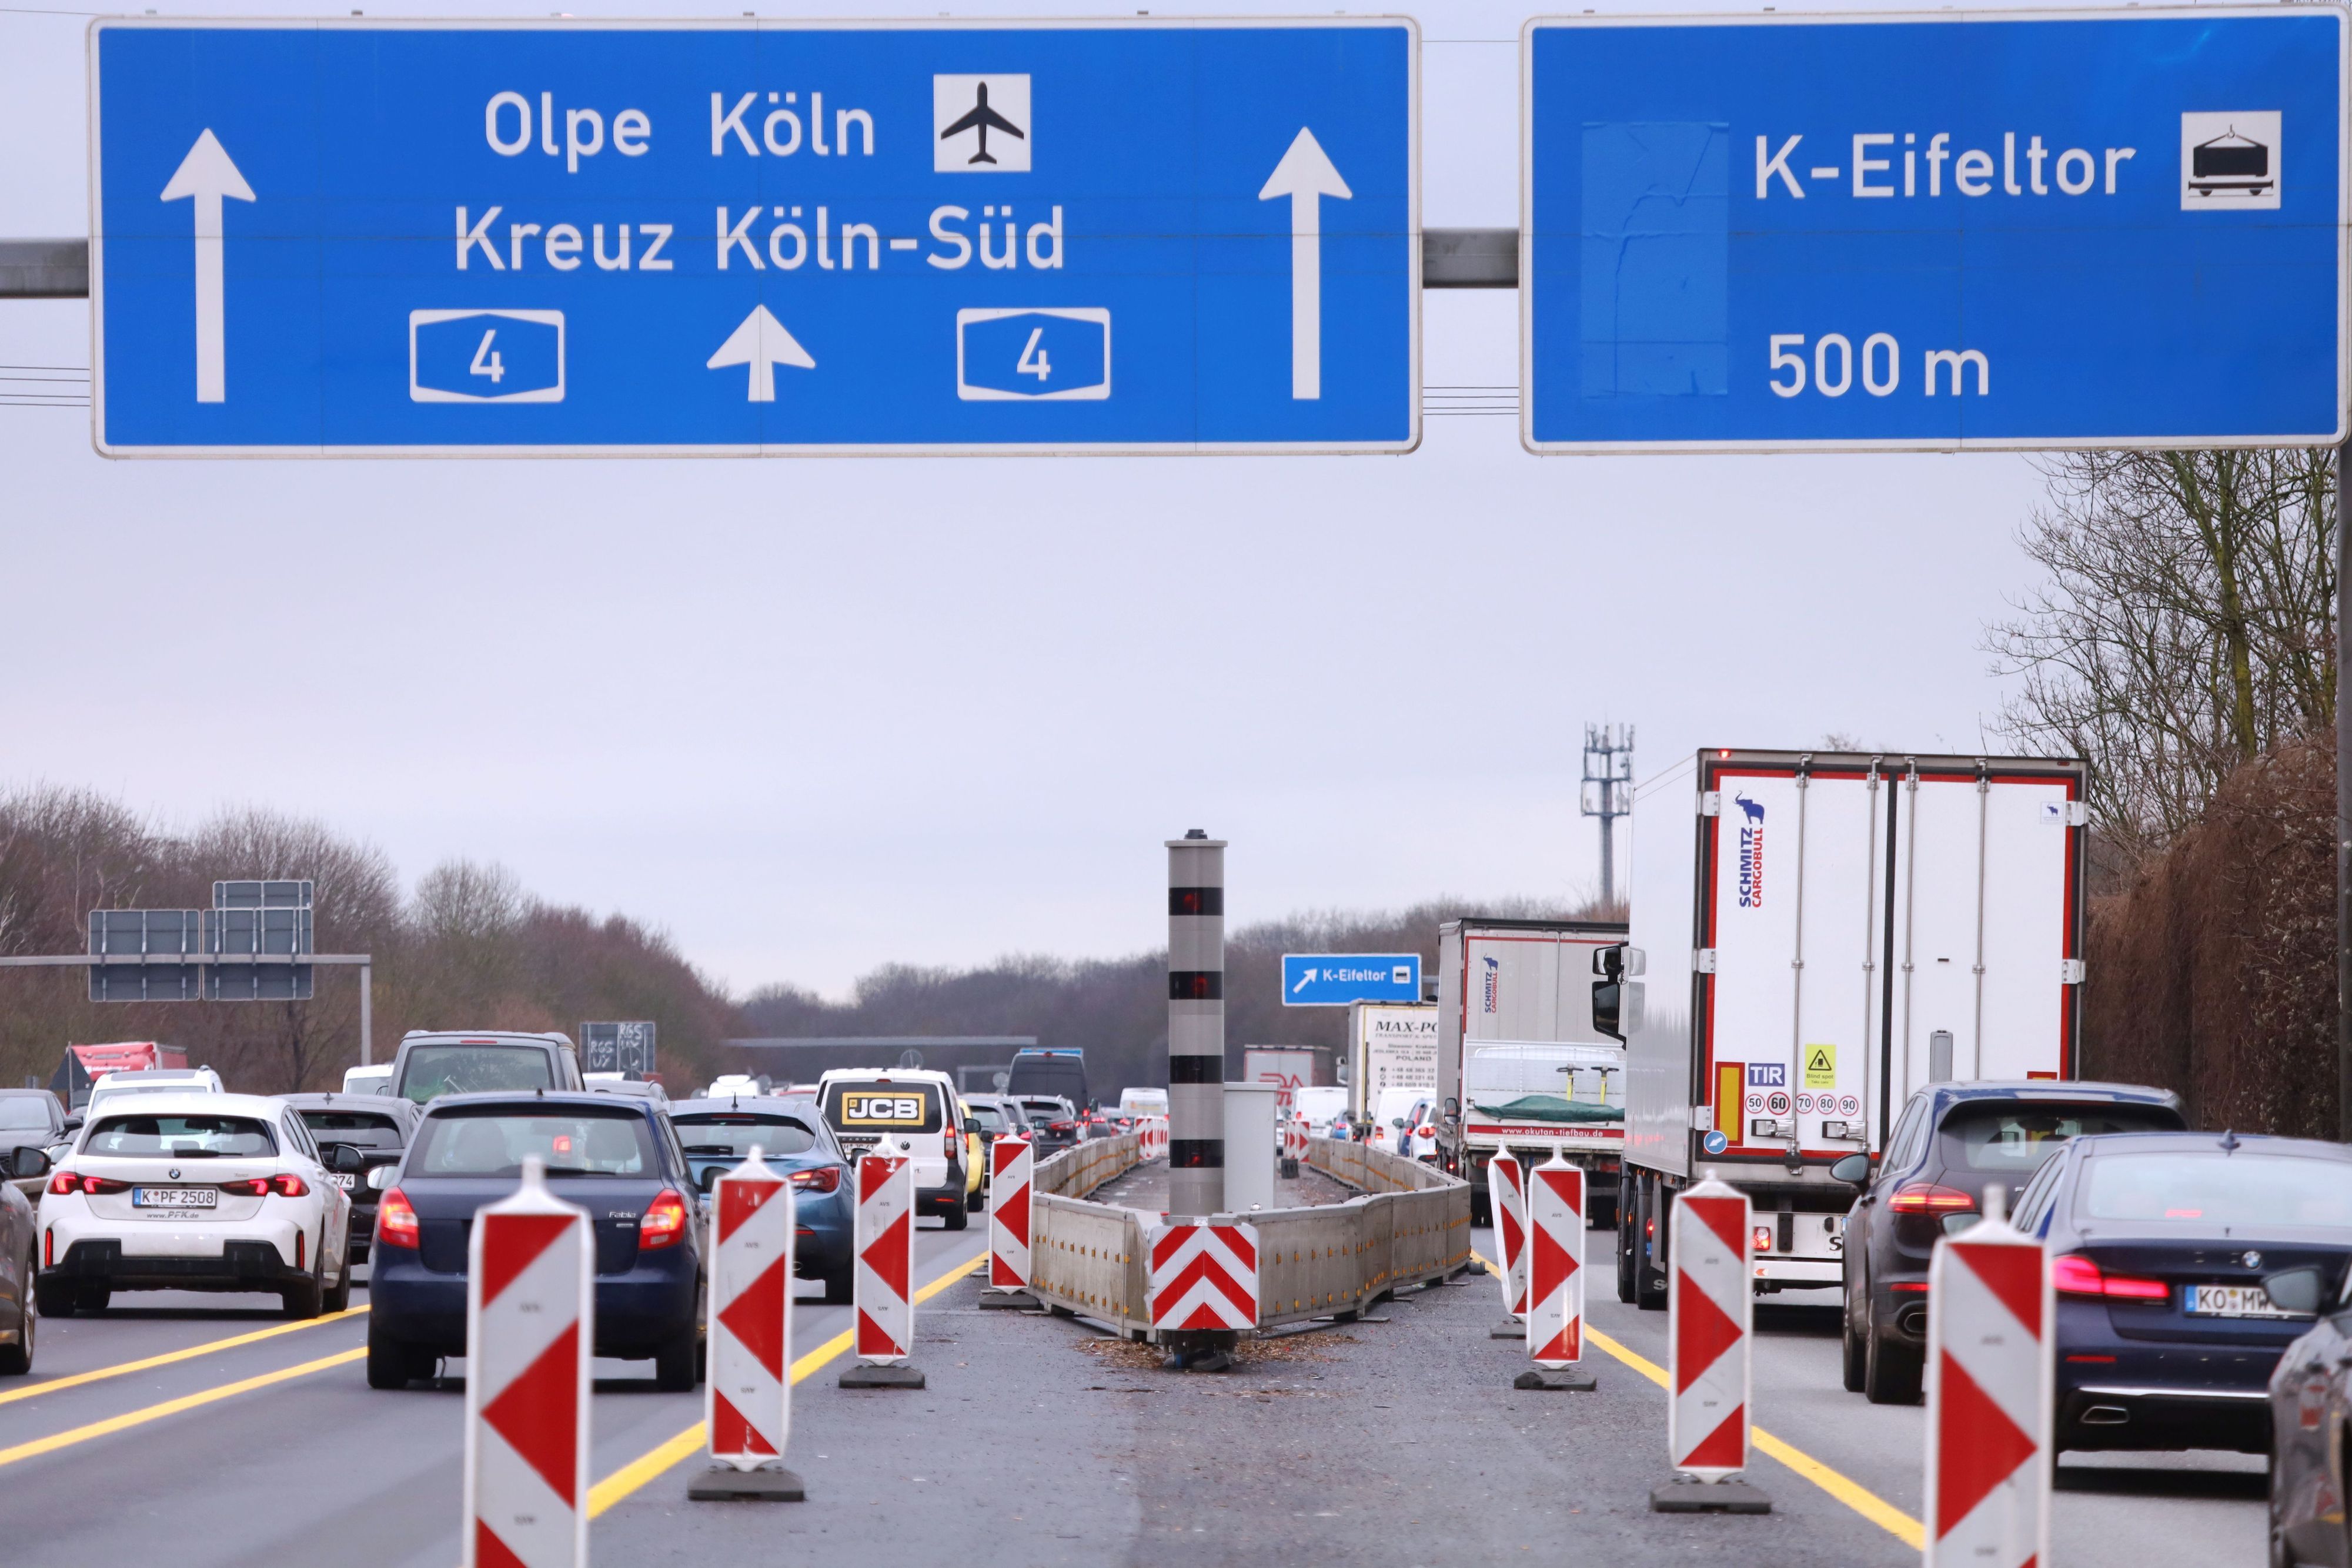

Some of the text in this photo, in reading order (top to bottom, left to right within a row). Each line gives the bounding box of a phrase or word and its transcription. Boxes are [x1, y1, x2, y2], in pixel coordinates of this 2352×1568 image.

[486, 91, 874, 173] Olpe Köln
[1756, 132, 2137, 199] K-Eifeltor
[456, 205, 1063, 270] Kreuz Köln-Süd
[470, 329, 505, 383] 4
[1017, 327, 1051, 381] 4
[1770, 332, 1989, 397] 500 m
[1739, 827, 1753, 907] SCHMITZ
[1752, 828, 1763, 908] CARGOBULL
[1323, 968, 1387, 981] K-Eifeltor
[620, 1024, 643, 1039] RGS
[590, 1040, 613, 1054] RGS
[1750, 1066, 1783, 1084] TIR
[848, 1098, 918, 1119] JCB
[1749, 1098, 1762, 1107] 50
[1771, 1097, 1786, 1109] 60
[1798, 1098, 1811, 1108] 70
[1820, 1099, 1833, 1109] 80
[1842, 1100, 1855, 1110] 90
[142, 1191, 151, 1203] K
[161, 1191, 178, 1203] PF
[181, 1192, 213, 1203] 2508
[2199, 1289, 2226, 1309] KO
